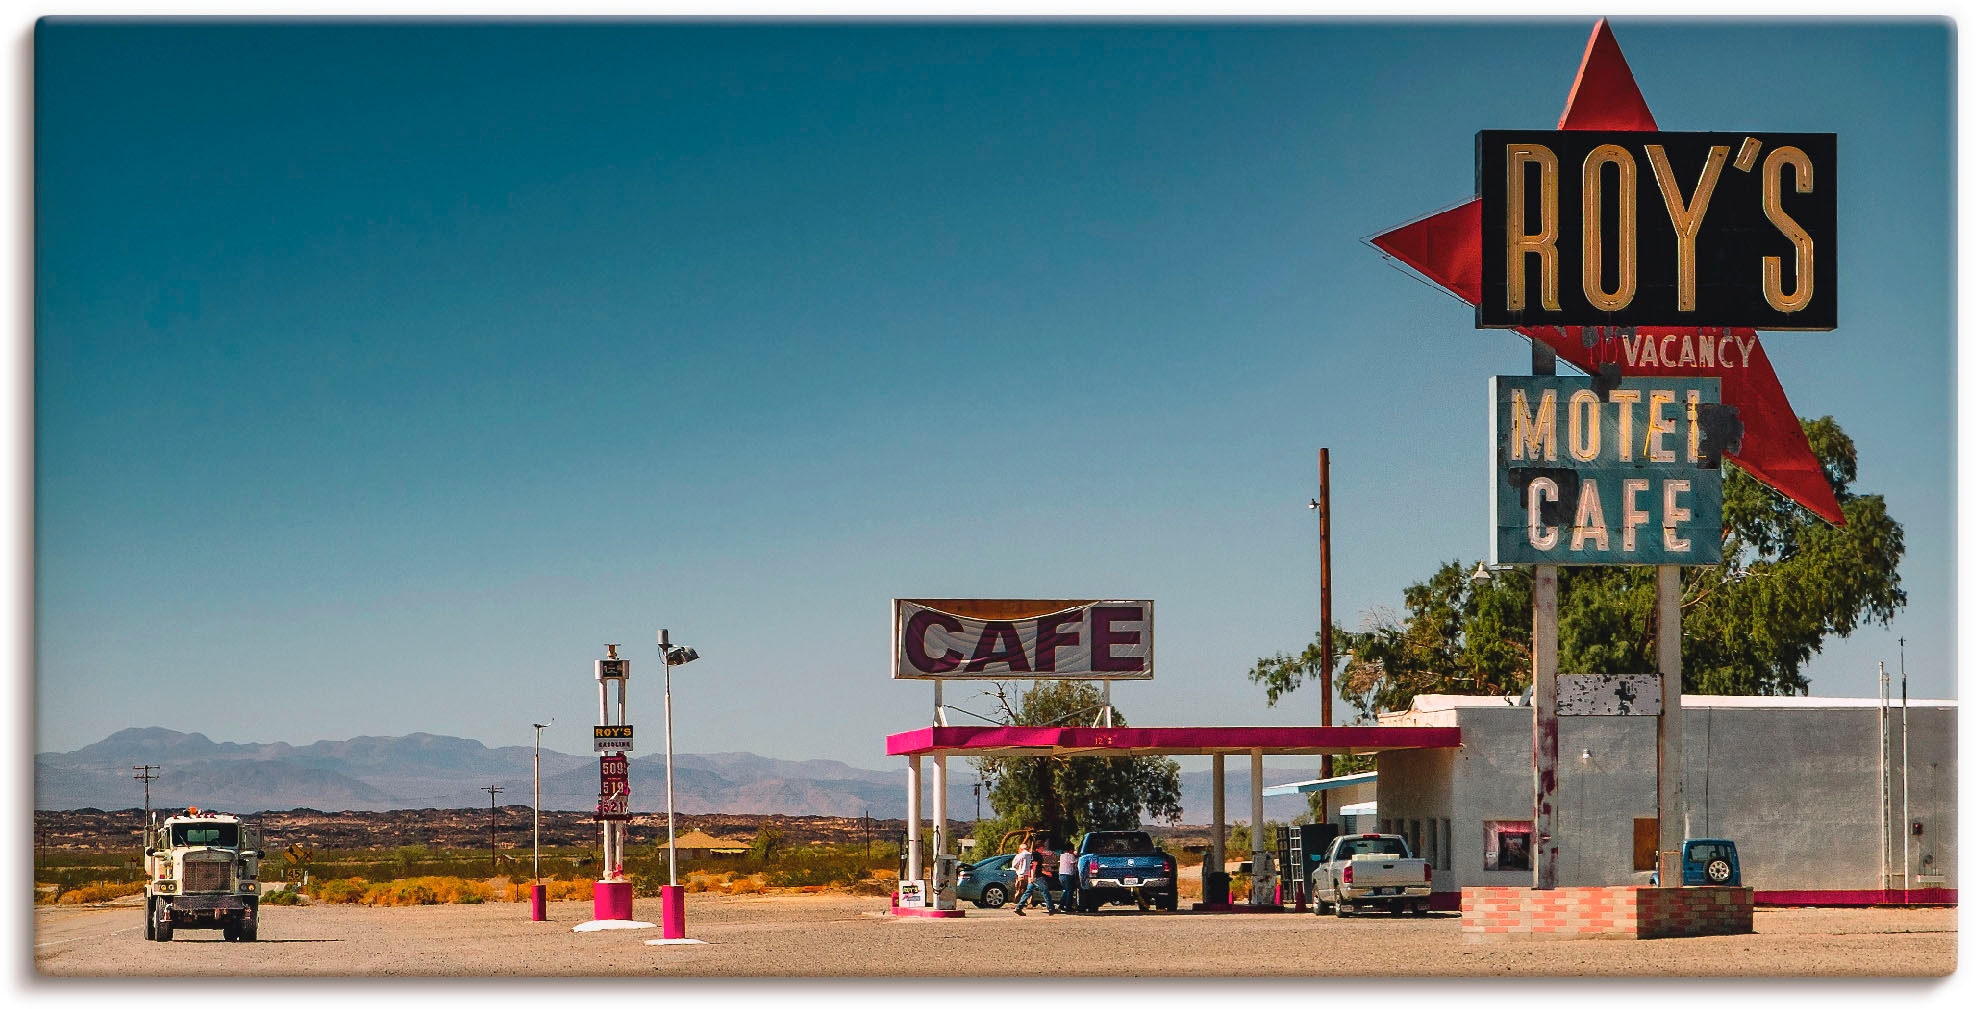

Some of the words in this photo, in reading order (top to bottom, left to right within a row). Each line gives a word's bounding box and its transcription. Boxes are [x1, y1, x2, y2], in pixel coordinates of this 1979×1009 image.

[1507, 137, 1813, 312] ROY'S
[1622, 334, 1757, 368] VACANCY
[1528, 477, 1692, 551] CAFE
[905, 606, 1145, 673] CAFE
[595, 728, 631, 736] ROY'S
